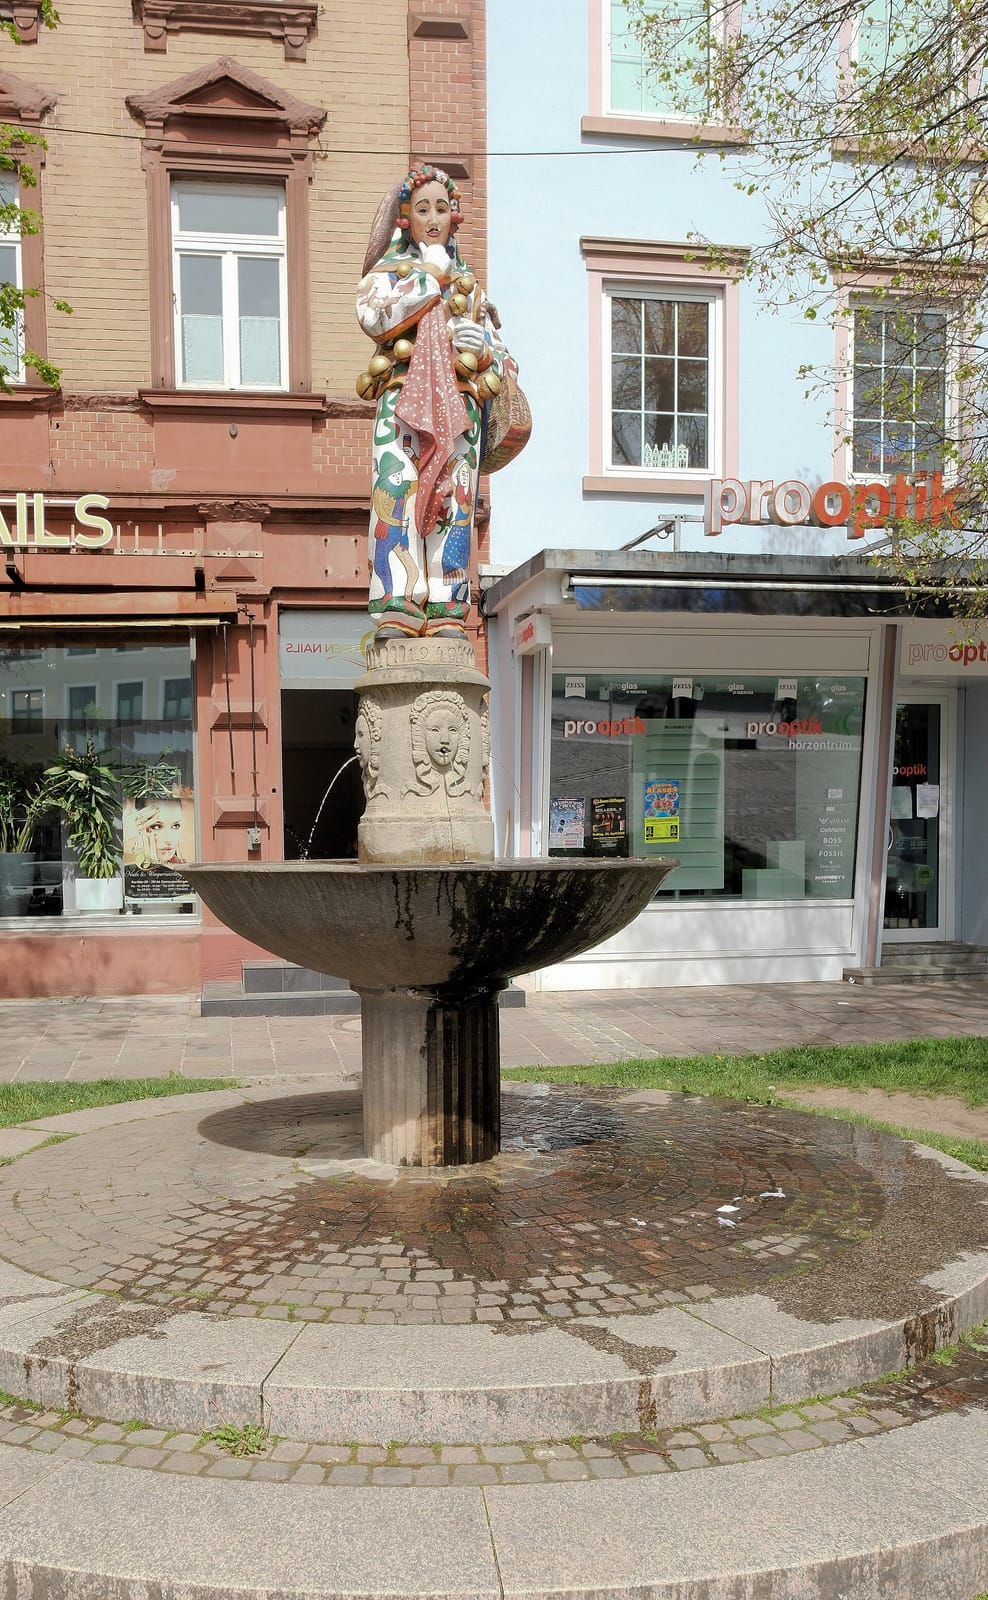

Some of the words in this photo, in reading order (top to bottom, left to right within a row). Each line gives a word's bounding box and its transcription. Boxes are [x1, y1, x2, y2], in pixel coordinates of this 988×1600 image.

[704, 470, 965, 540] prooptik
[909, 640, 988, 666] proopt
[564, 715, 647, 737] prooptik
[747, 715, 823, 737] prooptik
